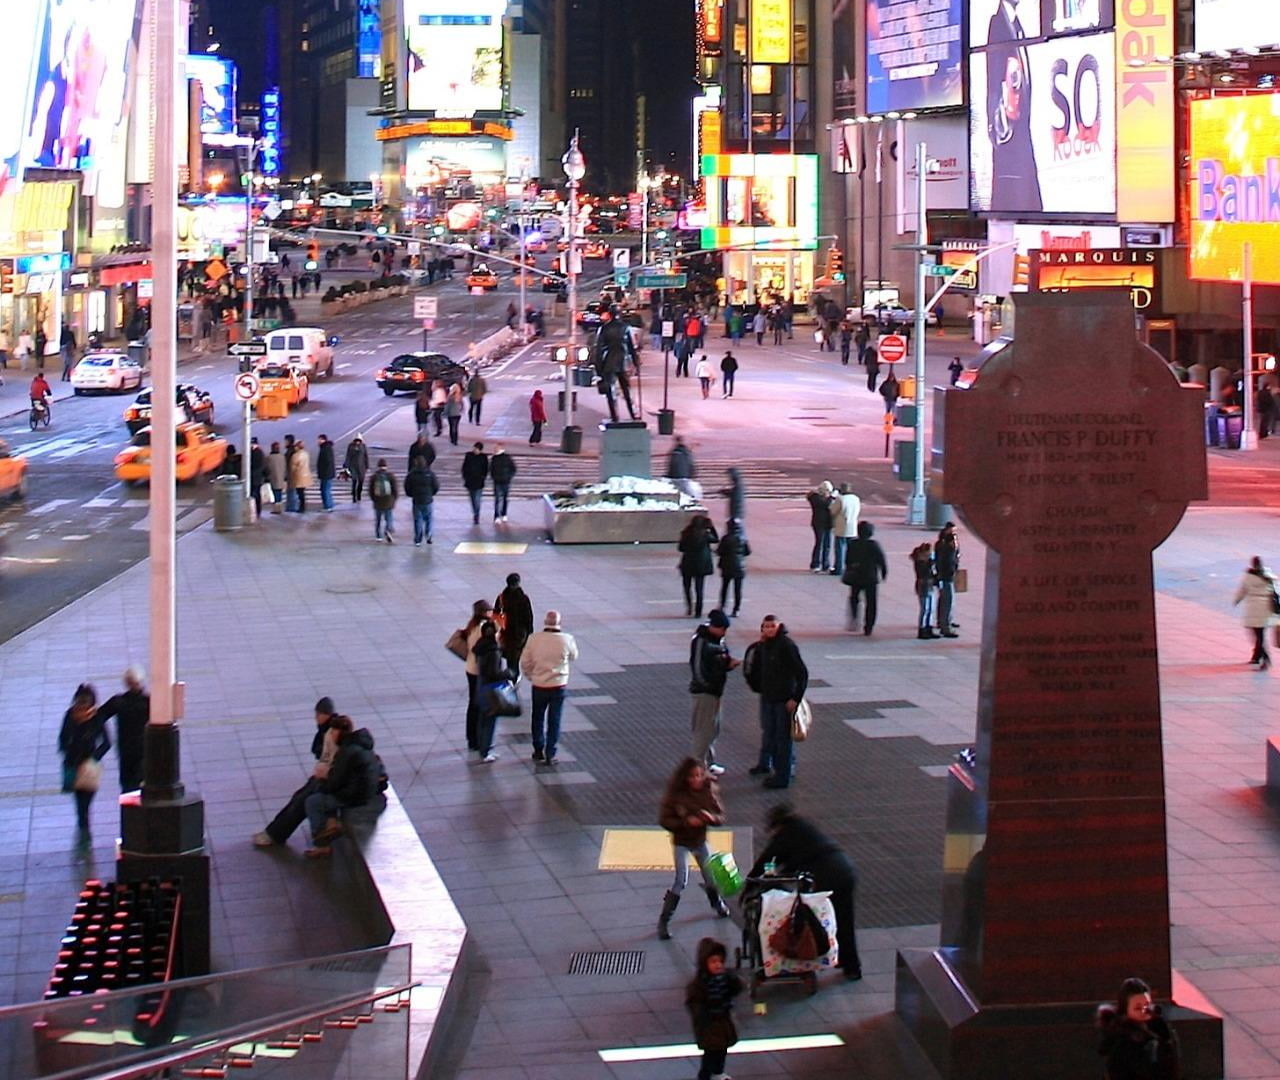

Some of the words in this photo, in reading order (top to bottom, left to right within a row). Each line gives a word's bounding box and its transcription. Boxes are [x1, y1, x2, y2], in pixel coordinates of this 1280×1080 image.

[1039, 251, 1155, 263] MARQUIS
[997, 430, 1072, 448] FRANCIS
[1096, 429, 1159, 448] DUFFY
[1090, 472, 1136, 485] PRIEST
